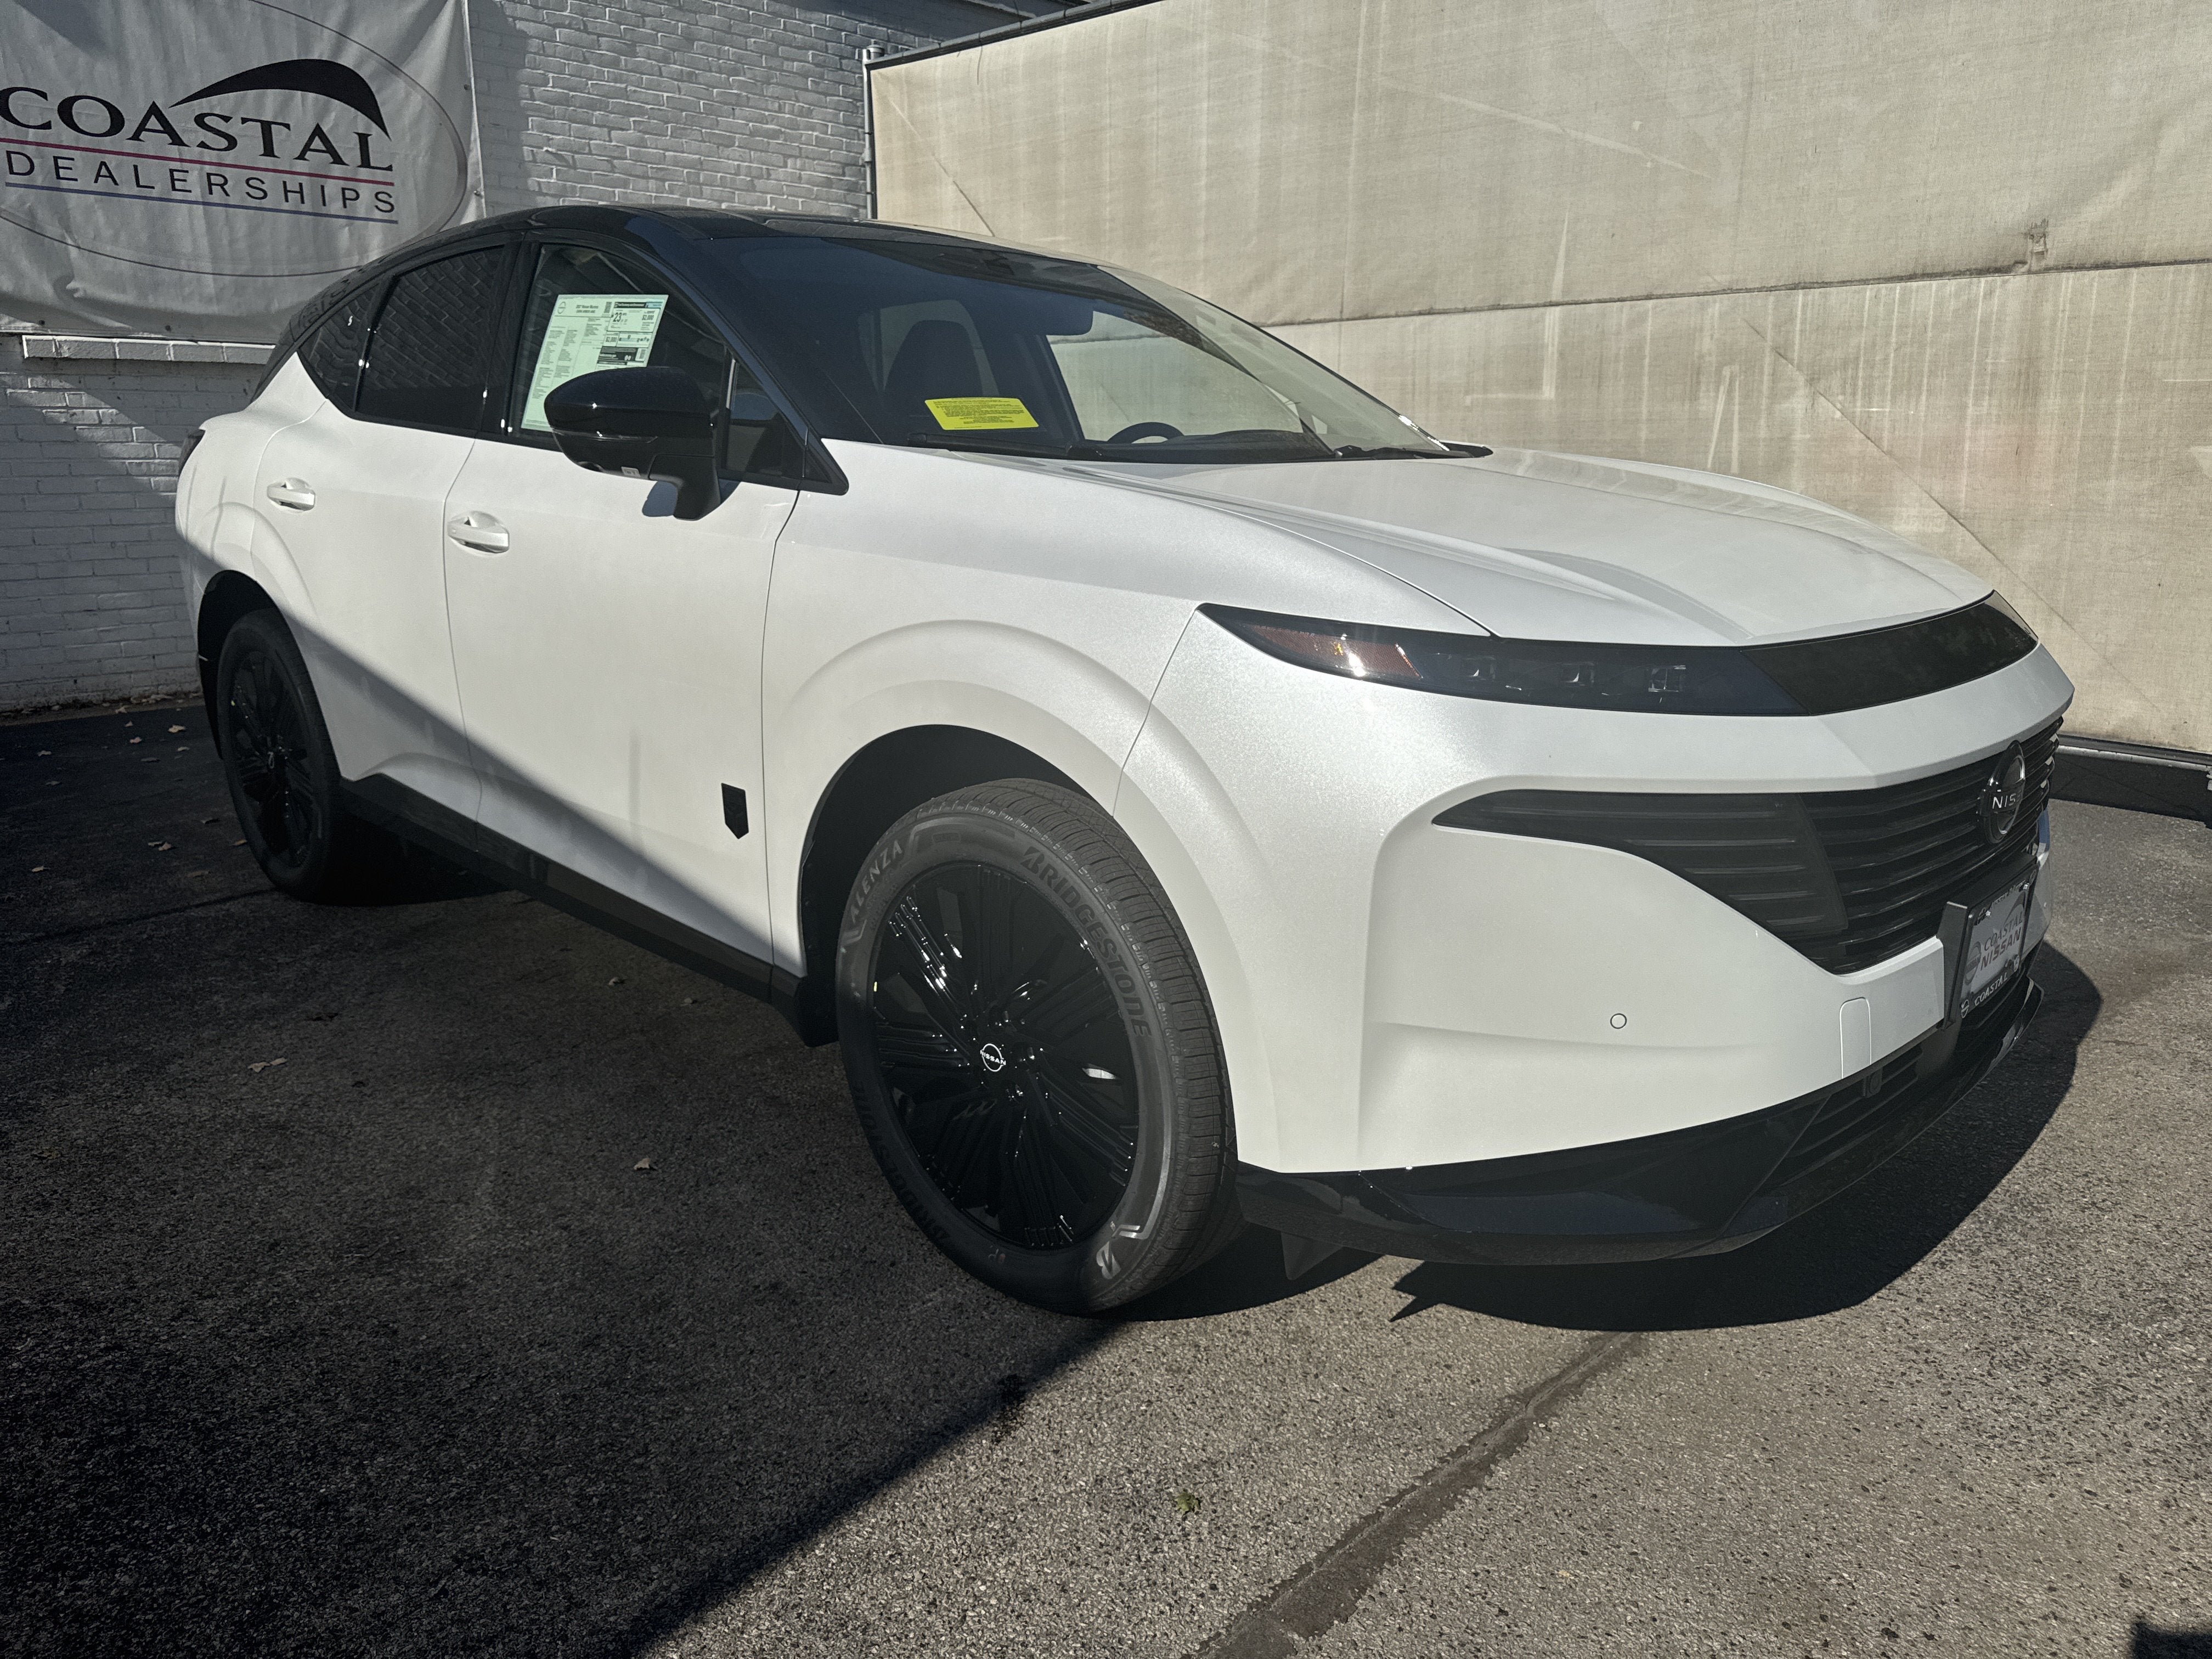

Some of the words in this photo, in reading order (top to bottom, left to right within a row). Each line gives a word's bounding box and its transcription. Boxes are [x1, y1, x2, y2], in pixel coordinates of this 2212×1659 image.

[0, 86, 393, 172] COASTAL
[6, 150, 396, 213] DEALERSHIPS
[851, 840, 902, 924] ALENZA
[1020, 847, 1152, 1037] BRIDGESTONE
[1980, 927, 2021, 970] NISSAN
[1984, 911, 2023, 951] COASTAL
[1975, 972, 2007, 1006] COASTAL
[980, 1049, 1006, 1065] NISSAN
